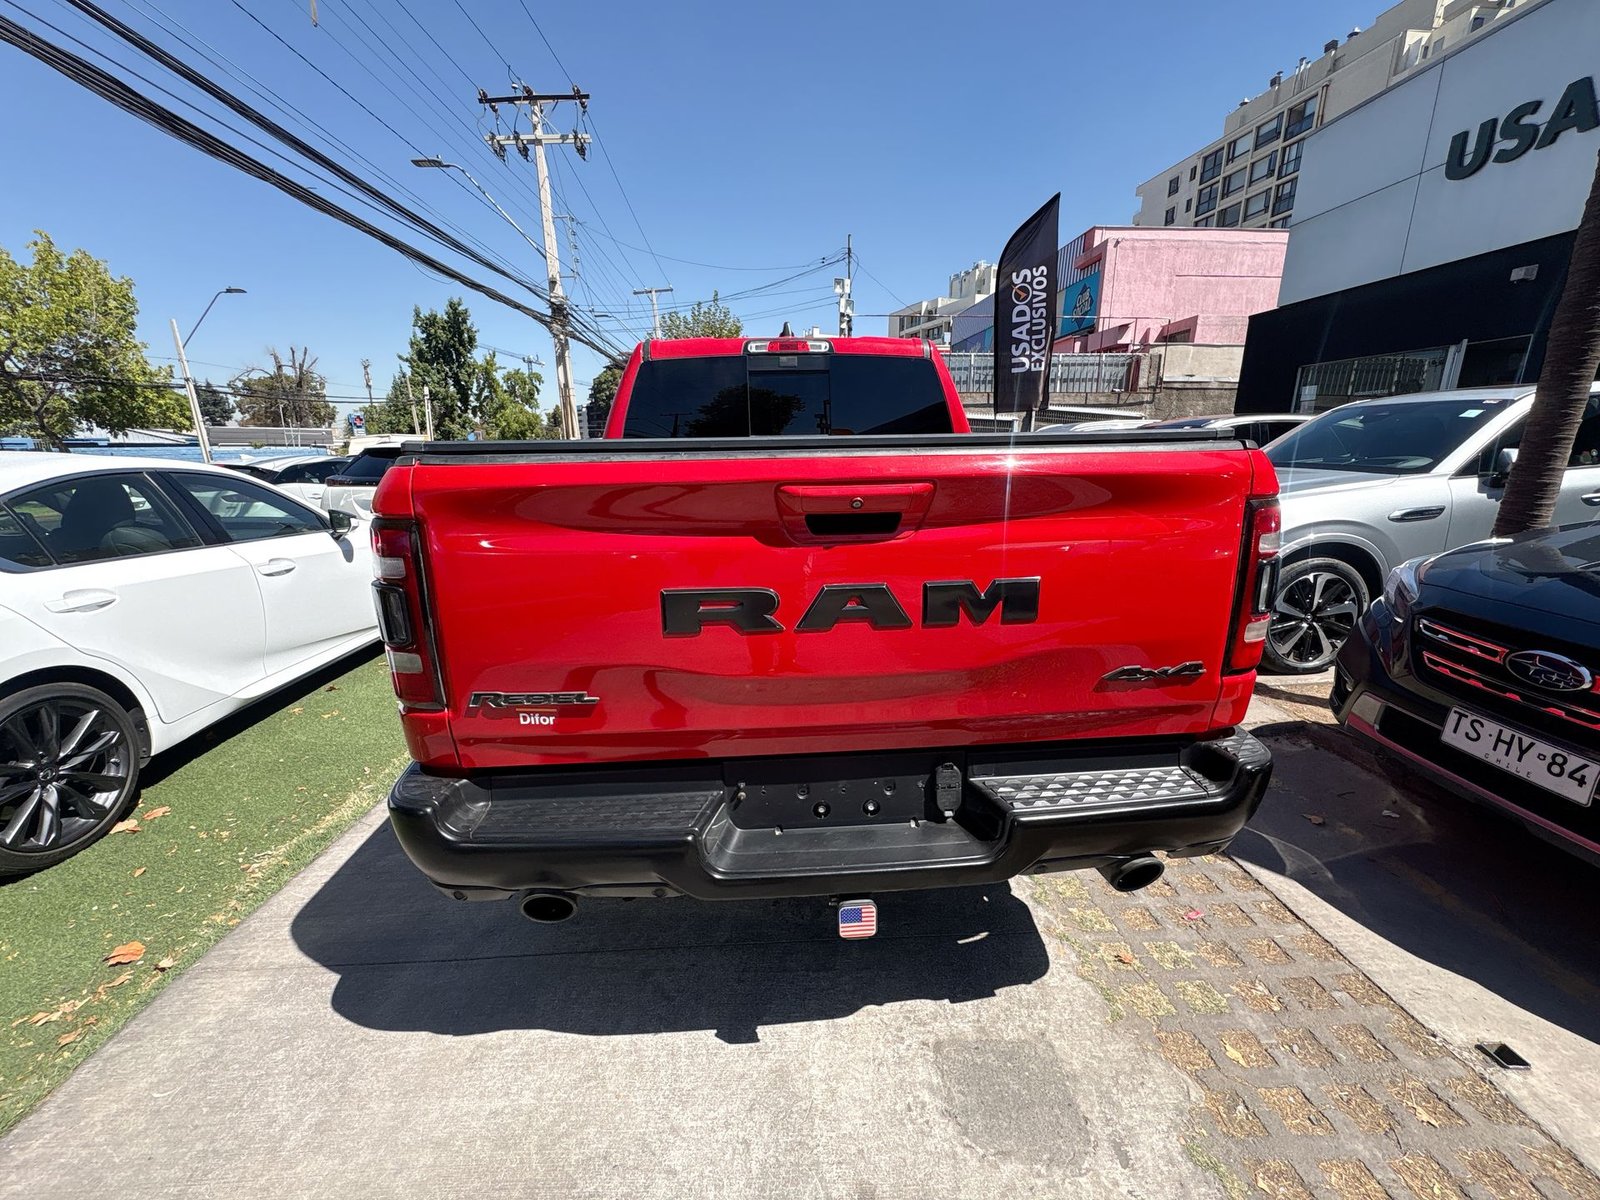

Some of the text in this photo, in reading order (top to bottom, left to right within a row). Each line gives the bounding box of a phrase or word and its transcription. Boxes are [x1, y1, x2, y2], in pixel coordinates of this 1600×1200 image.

[1011, 268, 1032, 373] USADOS
[1031, 265, 1047, 371] EXCLUSIVOS
[660, 575, 1041, 638] RAM
[469, 691, 600, 708] REBEL
[519, 712, 555, 725] Difor
[1484, 752, 1532, 779] CHILE
